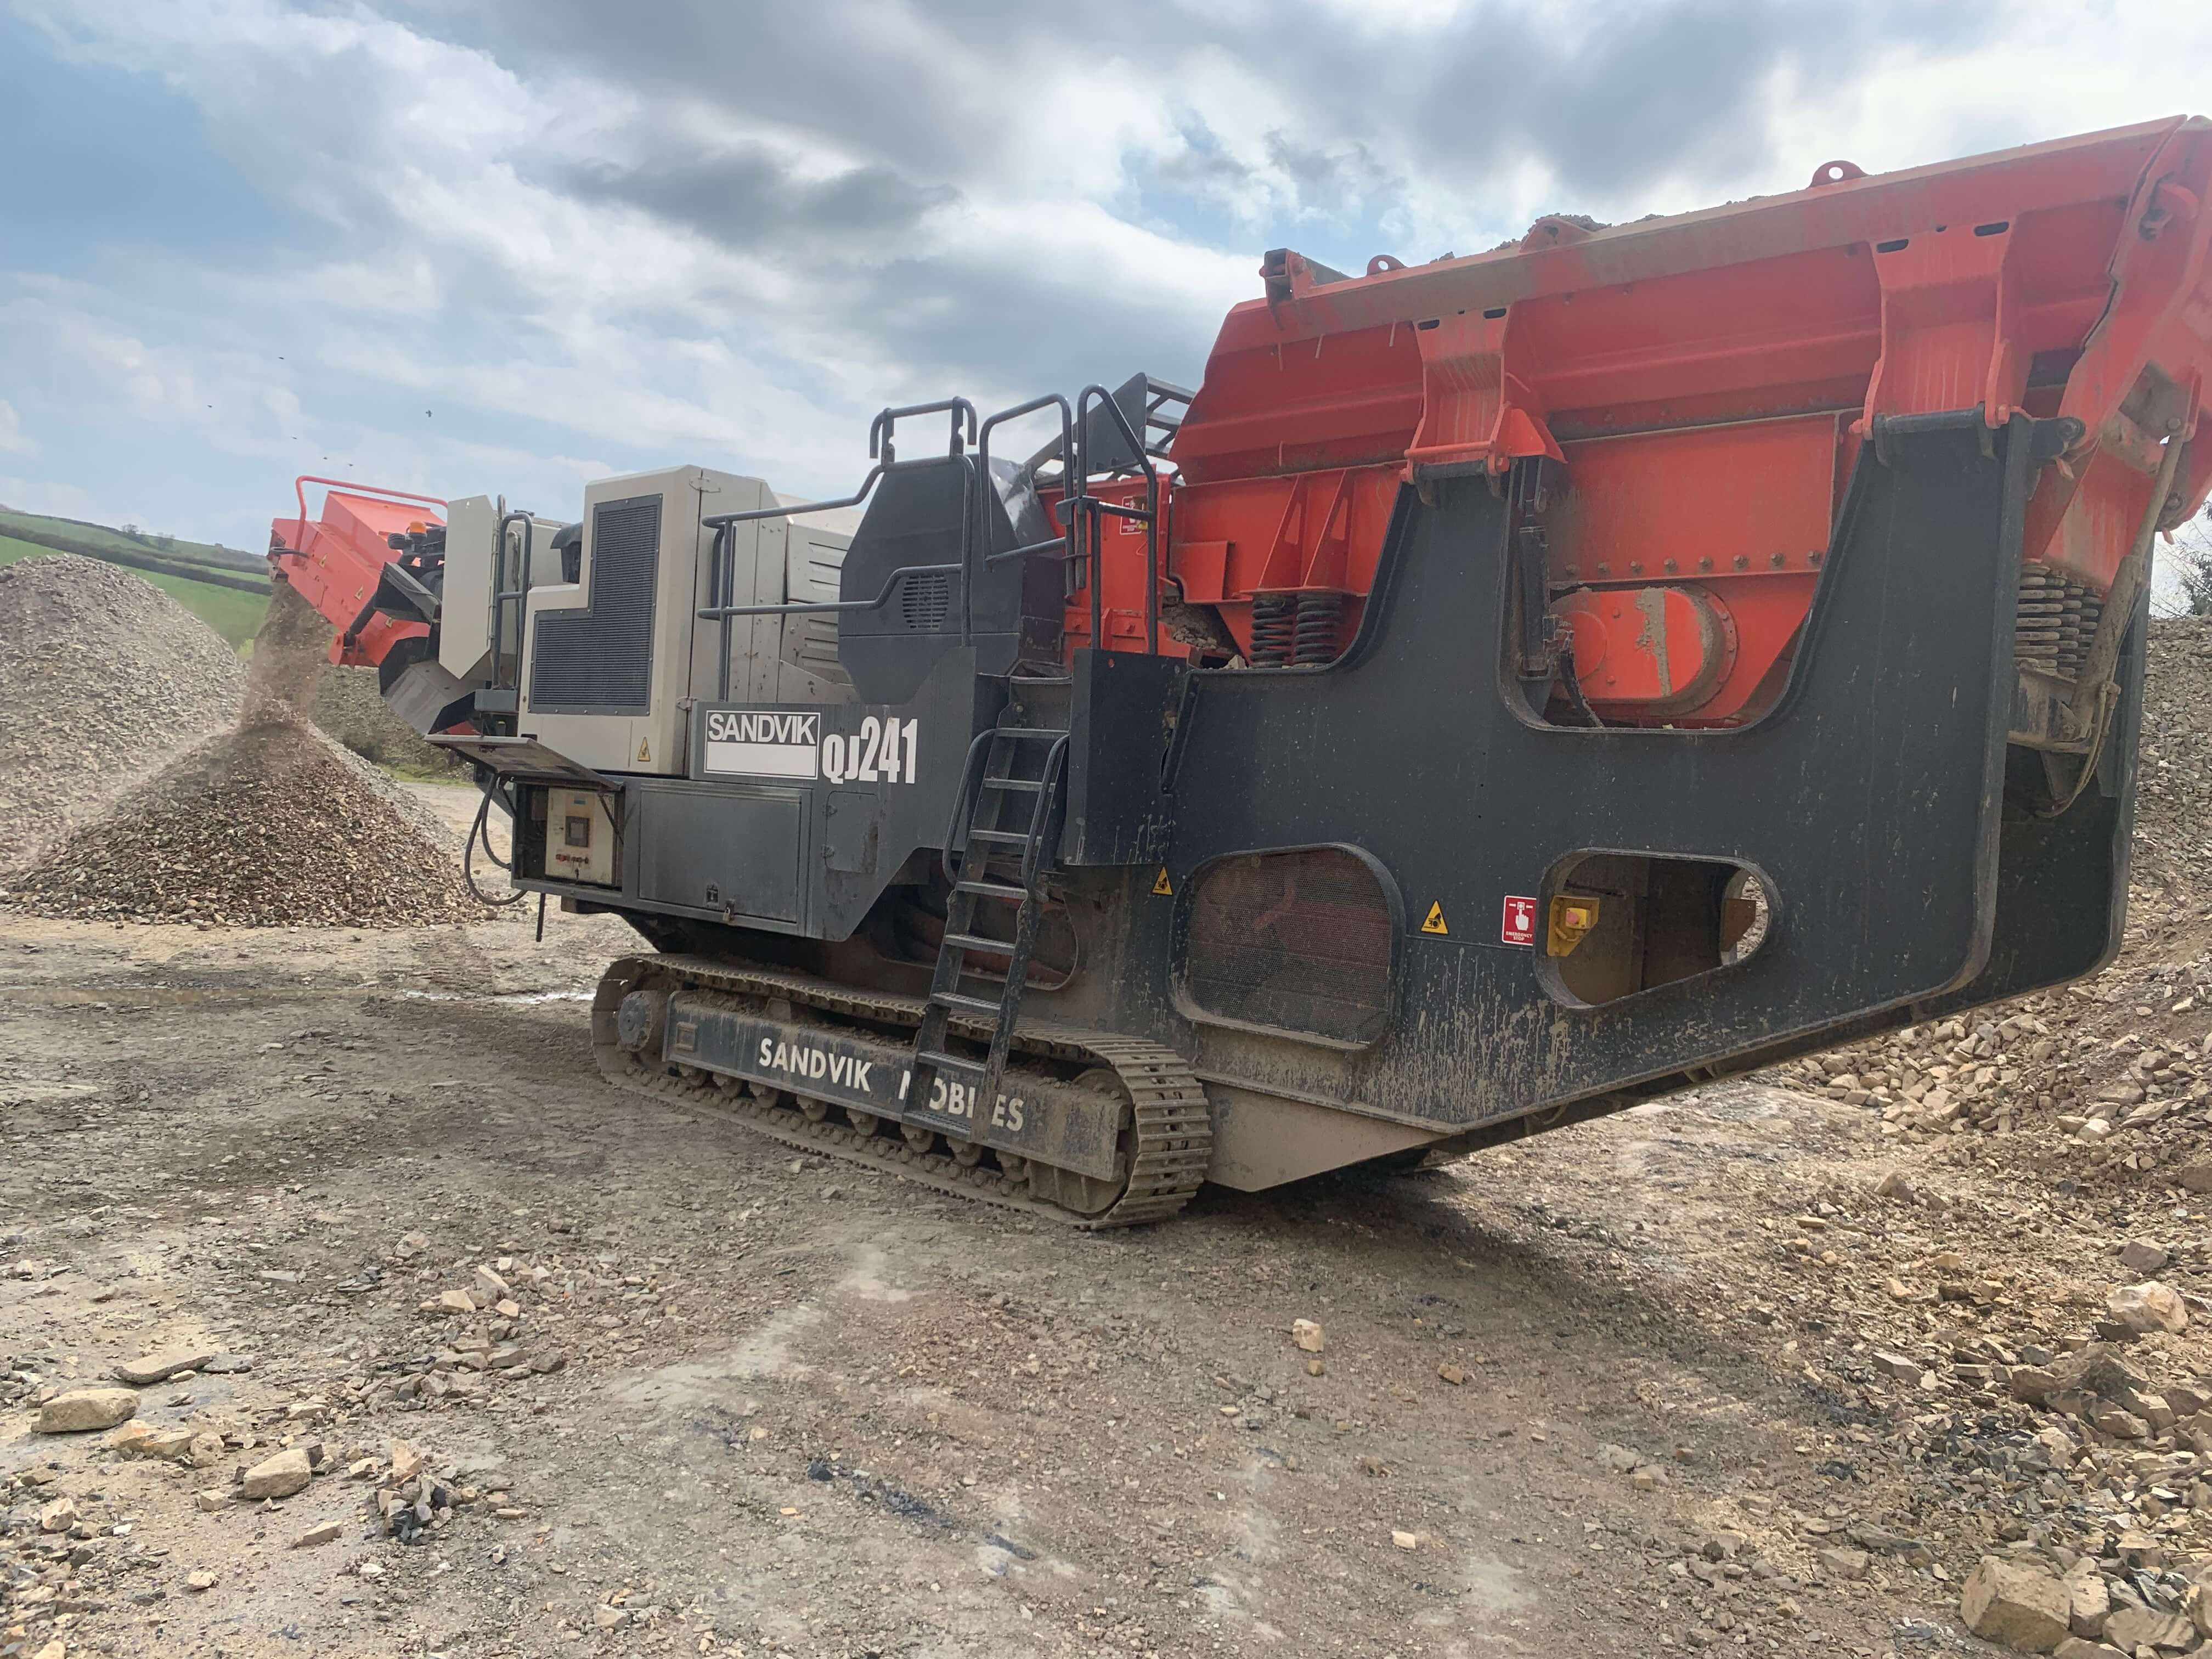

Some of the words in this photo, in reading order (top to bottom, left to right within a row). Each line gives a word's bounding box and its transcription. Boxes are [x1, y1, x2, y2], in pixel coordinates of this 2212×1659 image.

[708, 713, 816, 744] SANDVIK
[822, 716, 918, 785] QJ241
[759, 1037, 872, 1092] SANDVIK
[898, 1070, 1024, 1132] OBIES
